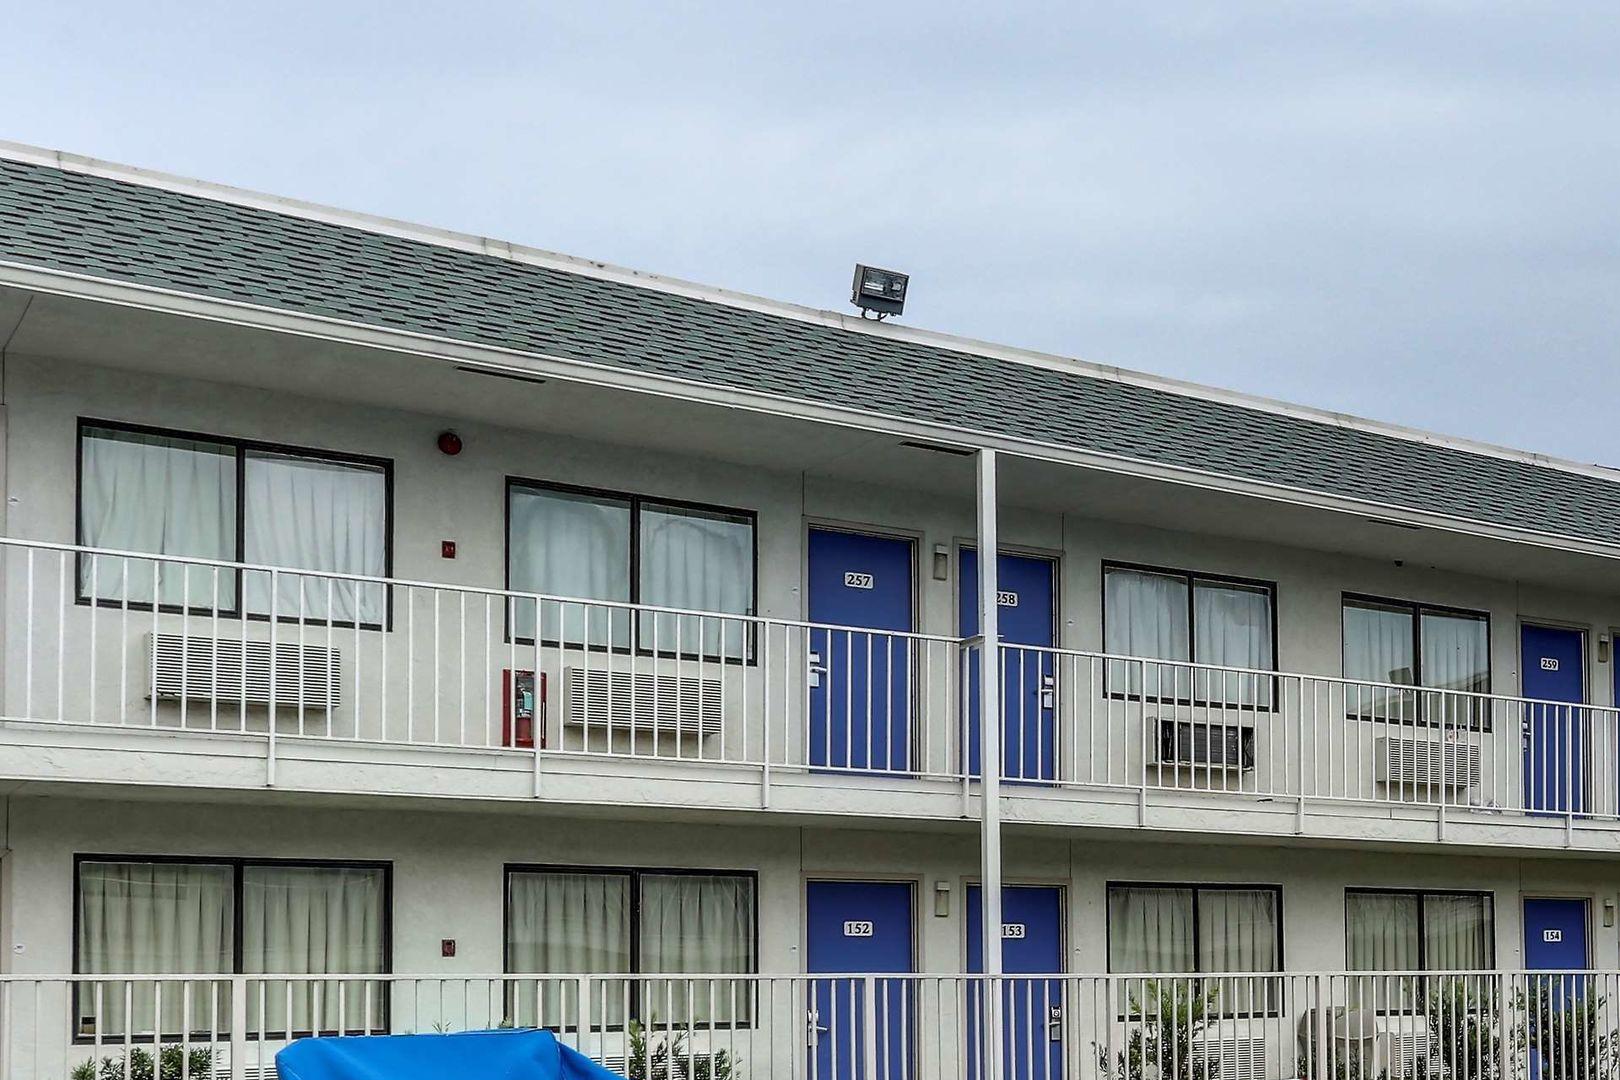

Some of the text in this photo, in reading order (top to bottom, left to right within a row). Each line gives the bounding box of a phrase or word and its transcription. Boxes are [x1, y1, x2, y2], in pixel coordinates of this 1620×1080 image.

[847, 573, 871, 587] 257
[997, 592, 1015, 604] 258
[1542, 659, 1557, 669] 259
[847, 922, 870, 935] 152
[1001, 925, 1021, 937] 153
[1544, 931, 1560, 941] 154
